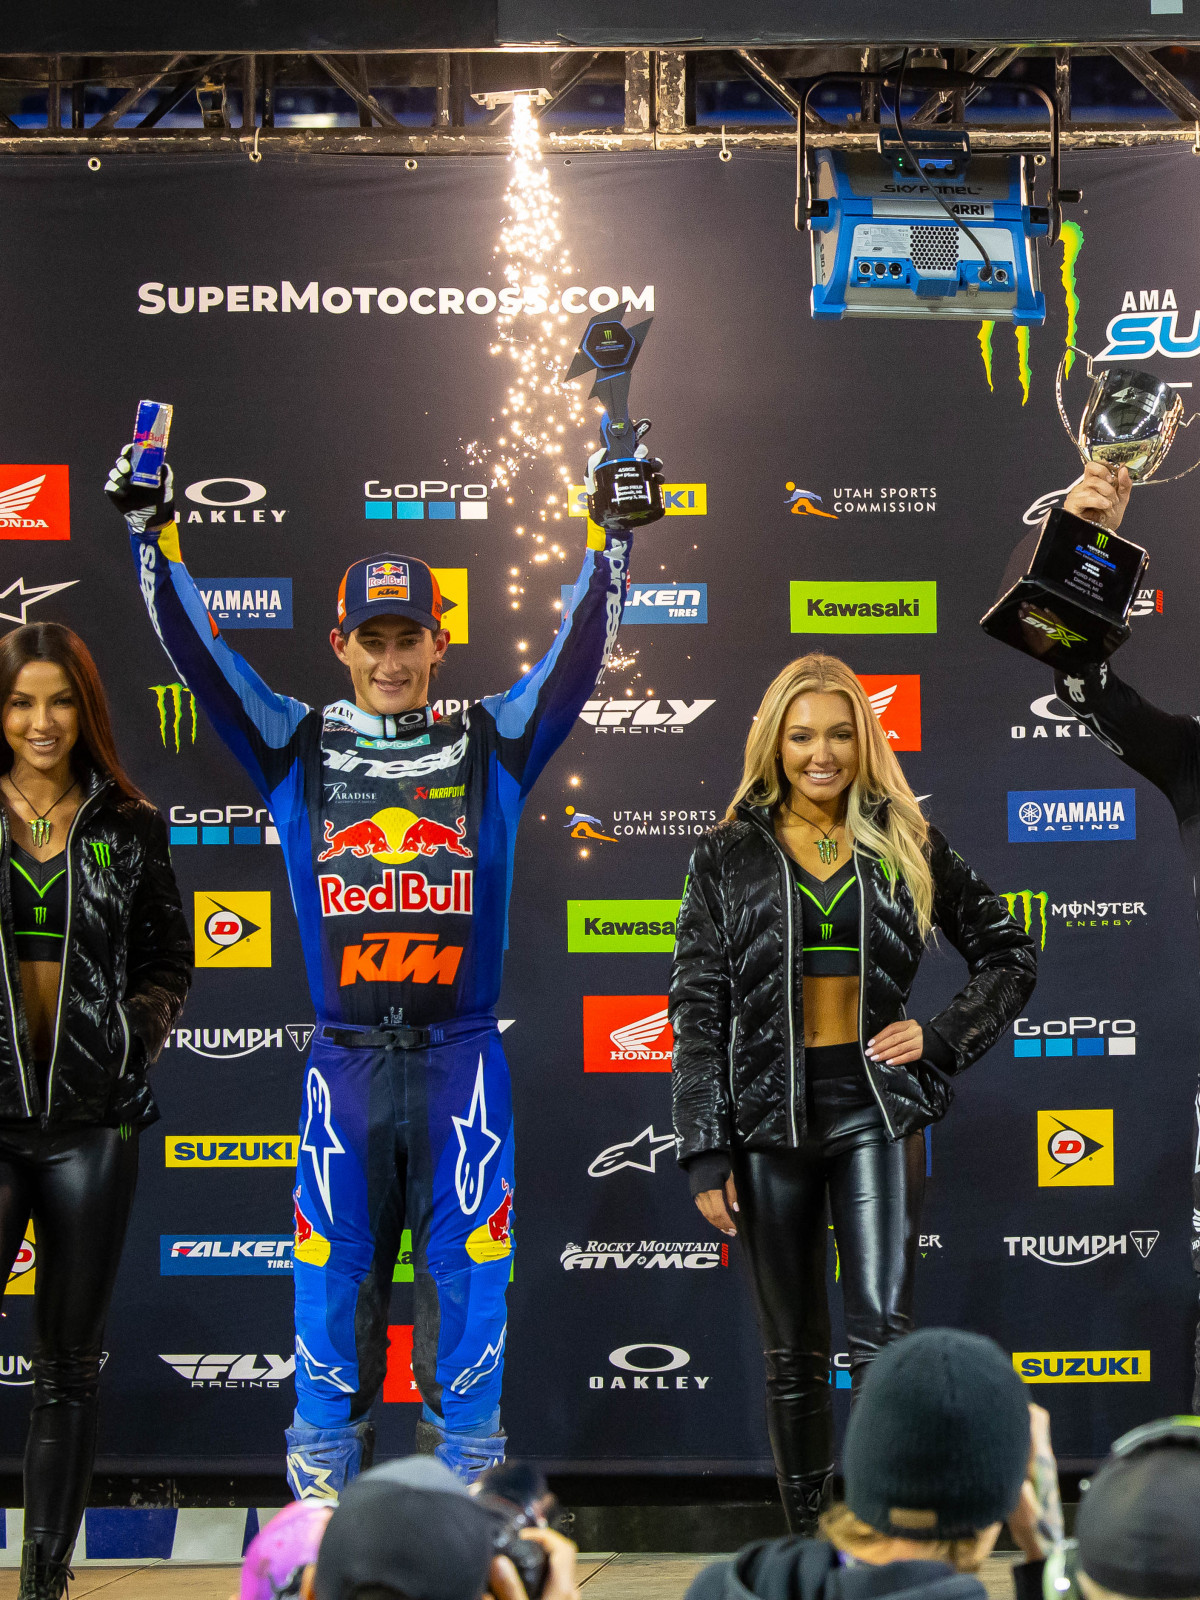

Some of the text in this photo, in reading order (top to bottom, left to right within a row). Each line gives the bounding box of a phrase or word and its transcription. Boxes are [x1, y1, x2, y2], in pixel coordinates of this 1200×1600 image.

[880, 183, 978, 196] SKYPNEL
[951, 203, 985, 216] ARRI
[137, 281, 655, 316] SUPERMOTOCROSS.COM
[1121, 288, 1178, 312] AMA
[364, 480, 488, 499] GoPro
[833, 487, 937, 499] UTAH SPORTS
[833, 502, 937, 513] COMMISSION
[0, 518, 49, 528] ONDA
[369, 575, 407, 588] Red Bull
[377, 588, 399, 596] KTM
[624, 589, 701, 607] KEN
[200, 590, 282, 611] YAMAHA
[806, 598, 920, 618] Kawasaki
[668, 608, 698, 618] TIRES
[594, 725, 684, 734] RACING
[1011, 724, 1092, 739] OAKL
[376, 737, 424, 749] MOTOREX
[320, 731, 470, 779] pinesta
[613, 809, 717, 822] UTAH SPORTS
[1042, 801, 1125, 823] YAMAHA
[1027, 824, 1120, 832] RACING
[318, 868, 474, 917] Red Bull
[1051, 900, 1148, 919] MONSTER
[584, 917, 679, 936] Kawasa
[1066, 919, 1133, 928] ENERGY
[340, 932, 464, 987] KTM
[1013, 1016, 1137, 1036] GoPro
[164, 1027, 283, 1059] TRIUMPH
[609, 1051, 673, 1061] HONDA
[174, 1141, 293, 1161] SUZUKI
[585, 1239, 720, 1253] ROCKY MOUNTAIN
[1003, 1234, 1127, 1267] TRIUMPH
[158, 1353, 296, 1380] FLY
[1020, 1356, 1139, 1377] SUZUKI
[191, 1380, 280, 1388] RACING
[589, 1375, 710, 1390] OAKLEY
